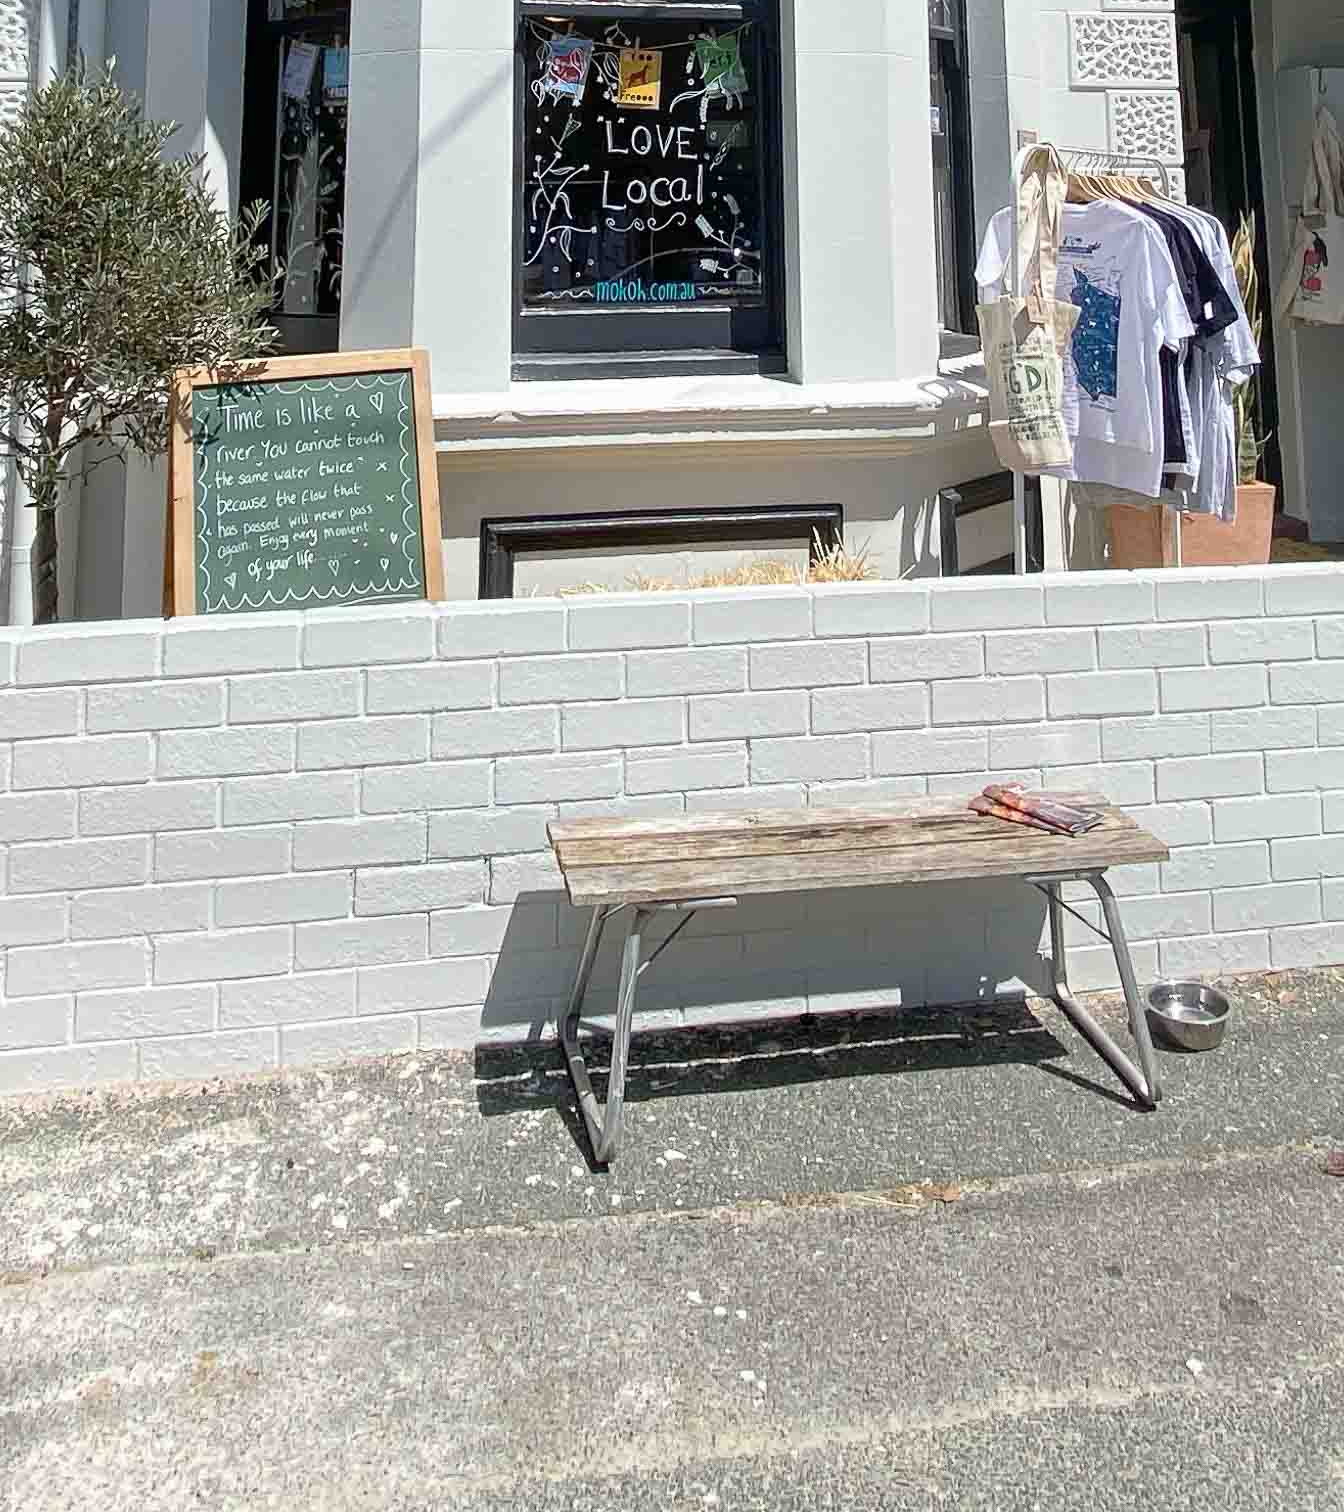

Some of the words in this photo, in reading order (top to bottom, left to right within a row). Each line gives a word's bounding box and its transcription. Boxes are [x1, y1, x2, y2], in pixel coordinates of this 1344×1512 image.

[606, 120, 698, 159] LOVE
[596, 278, 696, 302] mokoh.com.au
[217, 405, 265, 433] Time
[276, 407, 292, 426] is
[299, 396, 336, 424] like
[346, 403, 360, 419] a
[216, 445, 256, 463] river
[347, 431, 385, 447] touch
[215, 471, 235, 488] the
[238, 471, 268, 485] same
[274, 466, 311, 481] water
[318, 460, 354, 476] twice
[216, 494, 267, 516] because
[276, 490, 297, 507] the
[301, 489, 328, 505] flow
[333, 481, 362, 497] that
[217, 519, 238, 538] has
[243, 518, 280, 535] passed
[288, 513, 309, 528] will
[314, 508, 344, 522] never
[349, 504, 374, 518] pass
[247, 558, 263, 582] of
[265, 556, 293, 580] your
